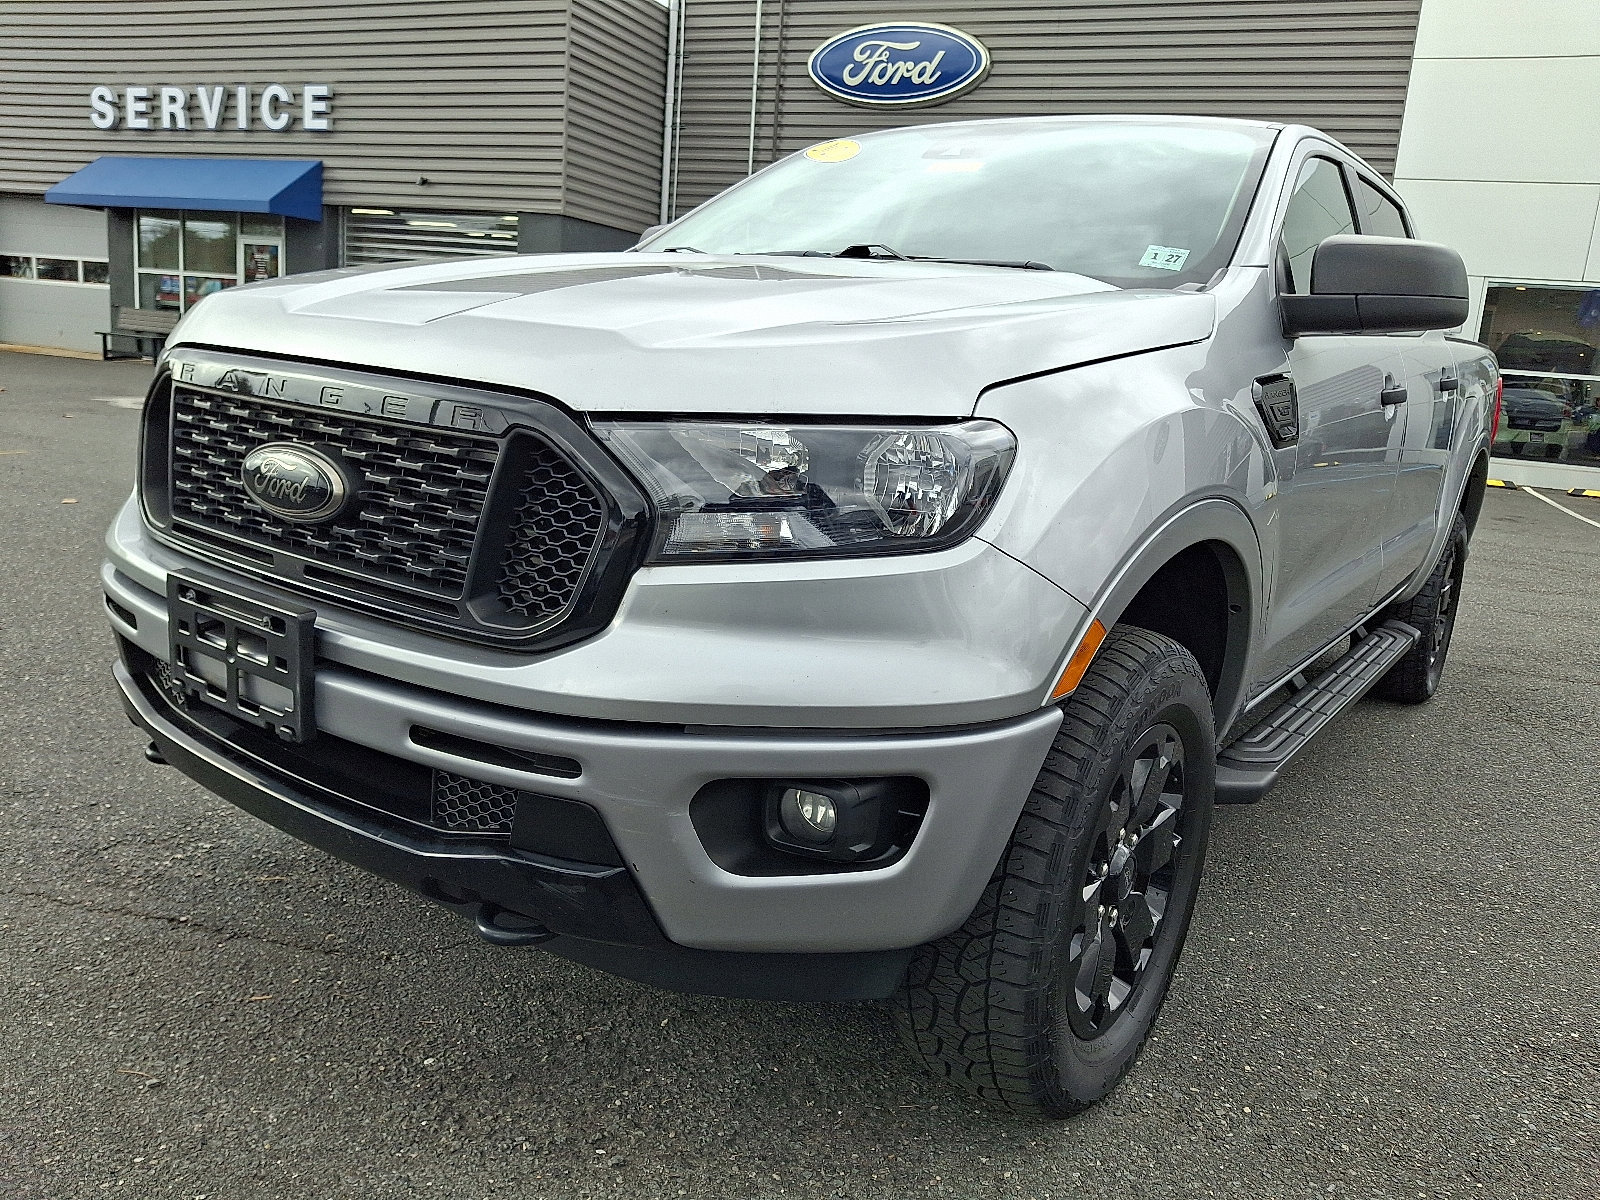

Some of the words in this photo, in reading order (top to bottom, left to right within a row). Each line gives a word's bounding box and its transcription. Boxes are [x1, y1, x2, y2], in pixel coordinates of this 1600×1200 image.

[842, 40, 946, 87] Ford
[89, 83, 334, 132] SERVICE
[1151, 252, 1159, 261] 1
[1165, 253, 1182, 264] 27
[180, 362, 484, 432] RANGER
[252, 456, 307, 504] Ford
